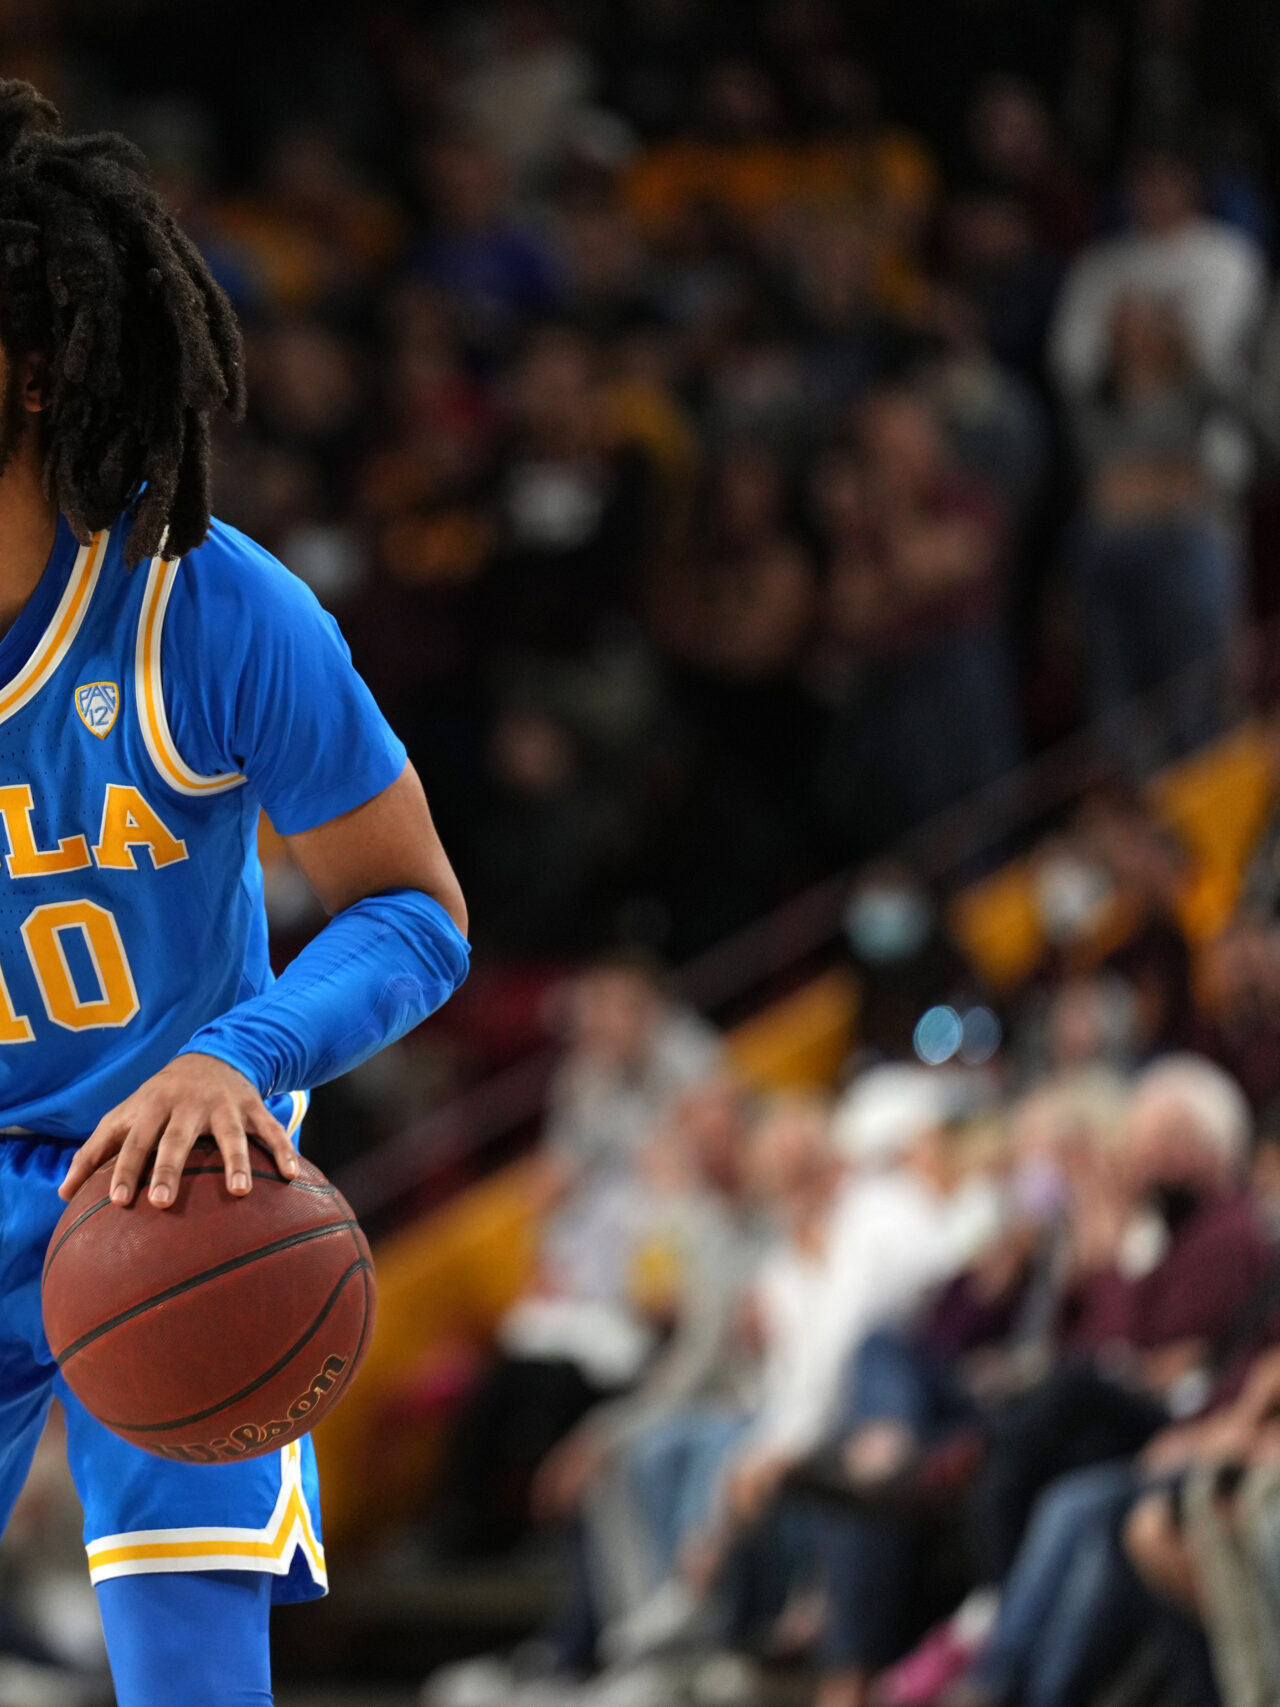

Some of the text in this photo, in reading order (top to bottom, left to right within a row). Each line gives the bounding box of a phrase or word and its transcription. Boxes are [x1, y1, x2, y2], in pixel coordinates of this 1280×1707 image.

[79, 685, 116, 718] PAC
[89, 706, 110, 726] 12
[144, 1353, 348, 1463] Wilson
